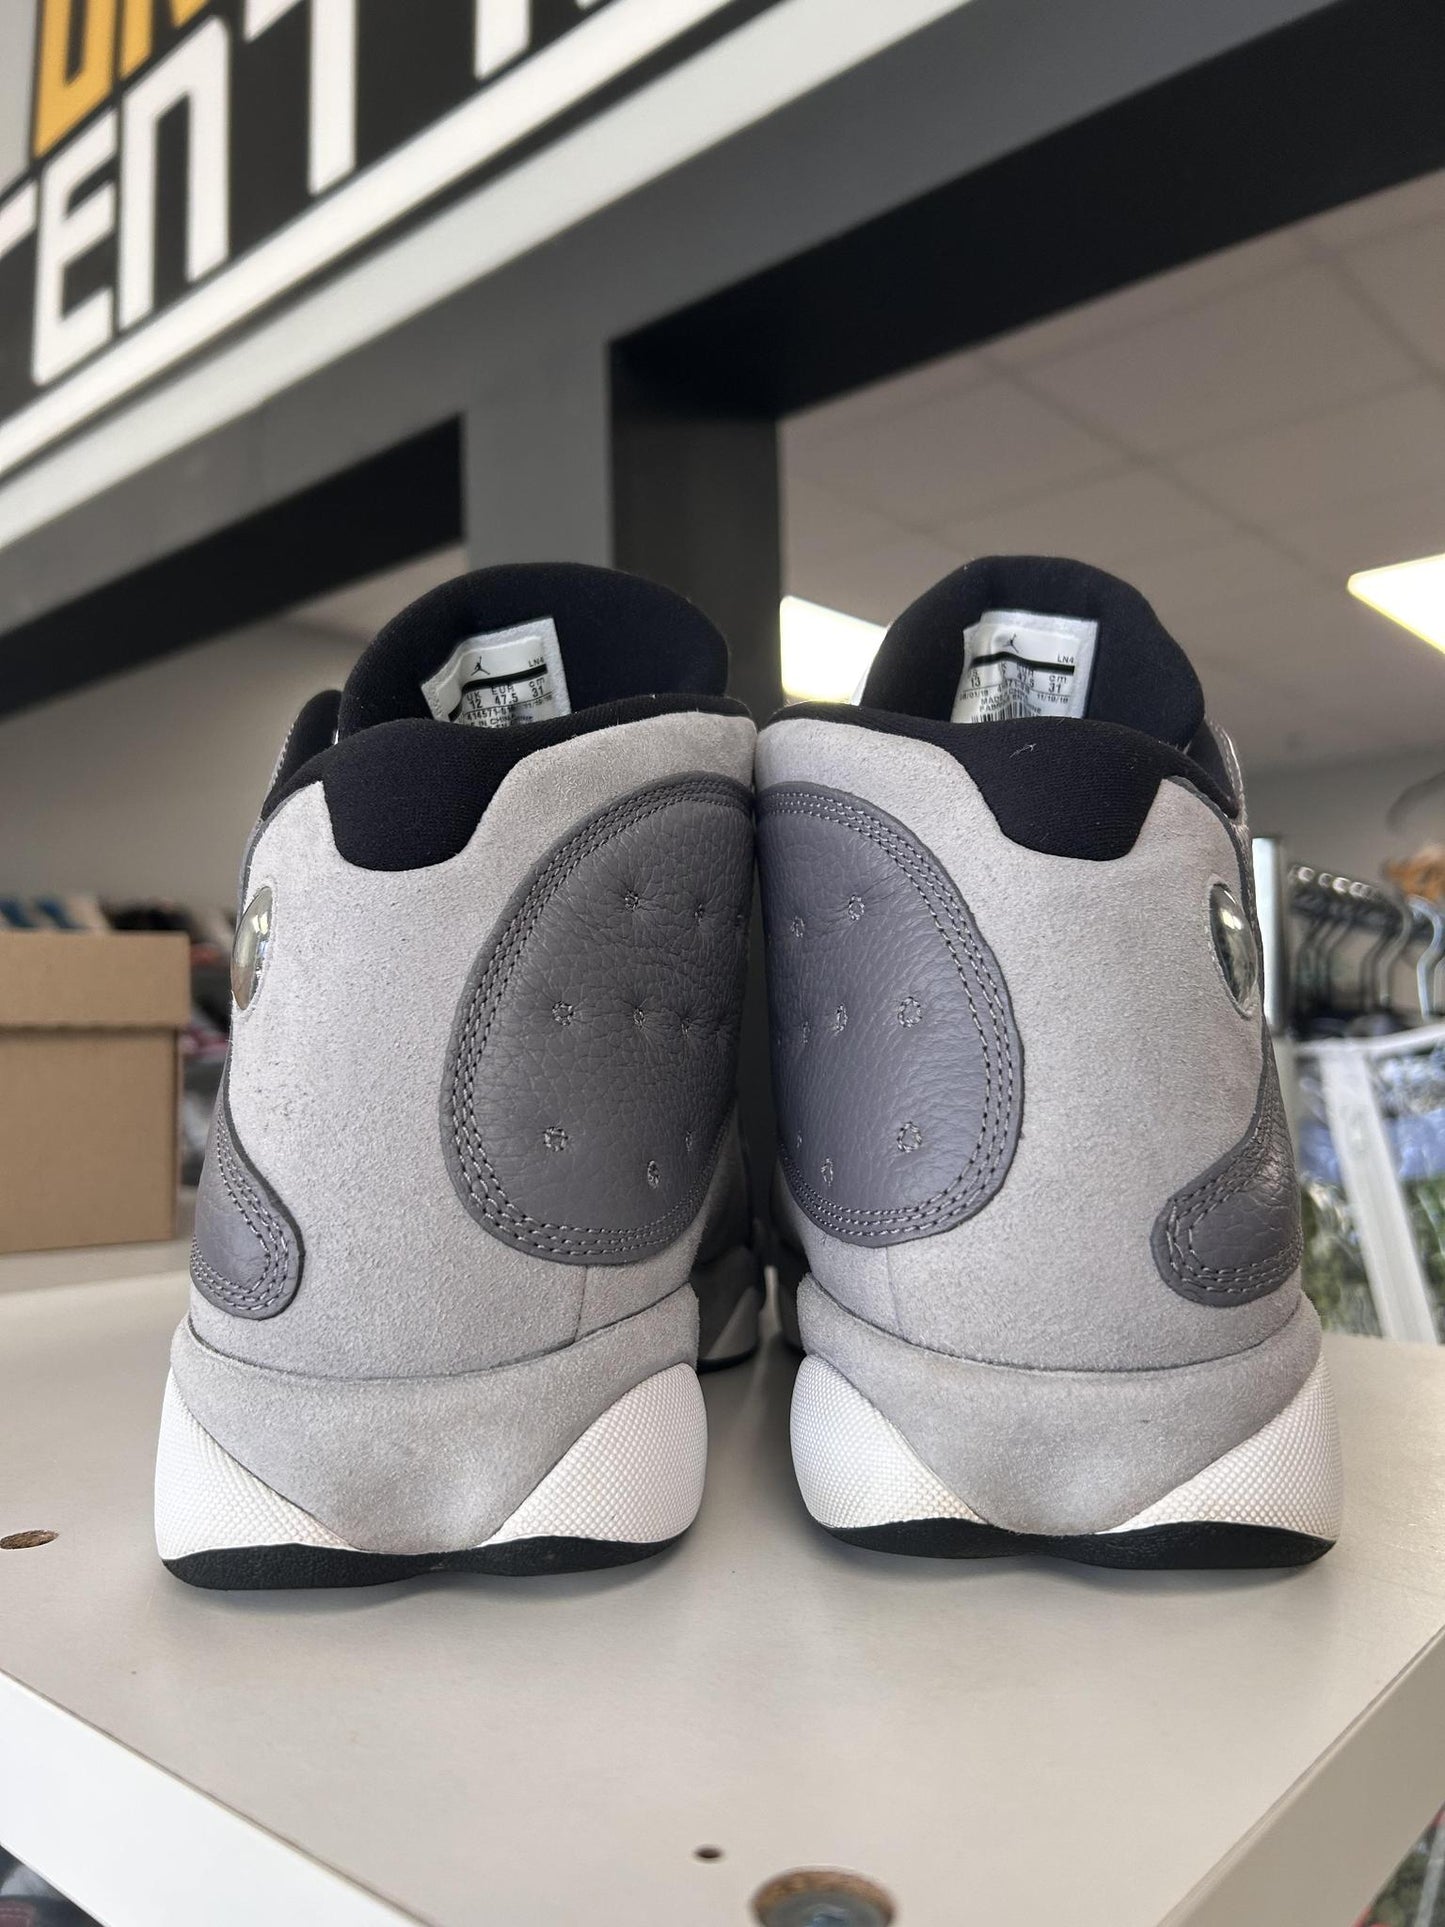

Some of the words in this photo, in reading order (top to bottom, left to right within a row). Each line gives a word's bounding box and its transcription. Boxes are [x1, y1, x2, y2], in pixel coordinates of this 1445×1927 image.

[528, 656, 545, 668] LN4
[1057, 654, 1074, 664] LN4
[528, 677, 545, 688] cm
[1048, 674, 1067, 684] cm
[1048, 683, 1062, 694] 31
[469, 698, 483, 711] 12
[494, 692, 519, 706] 47.5
[531, 685, 545, 698] 31
